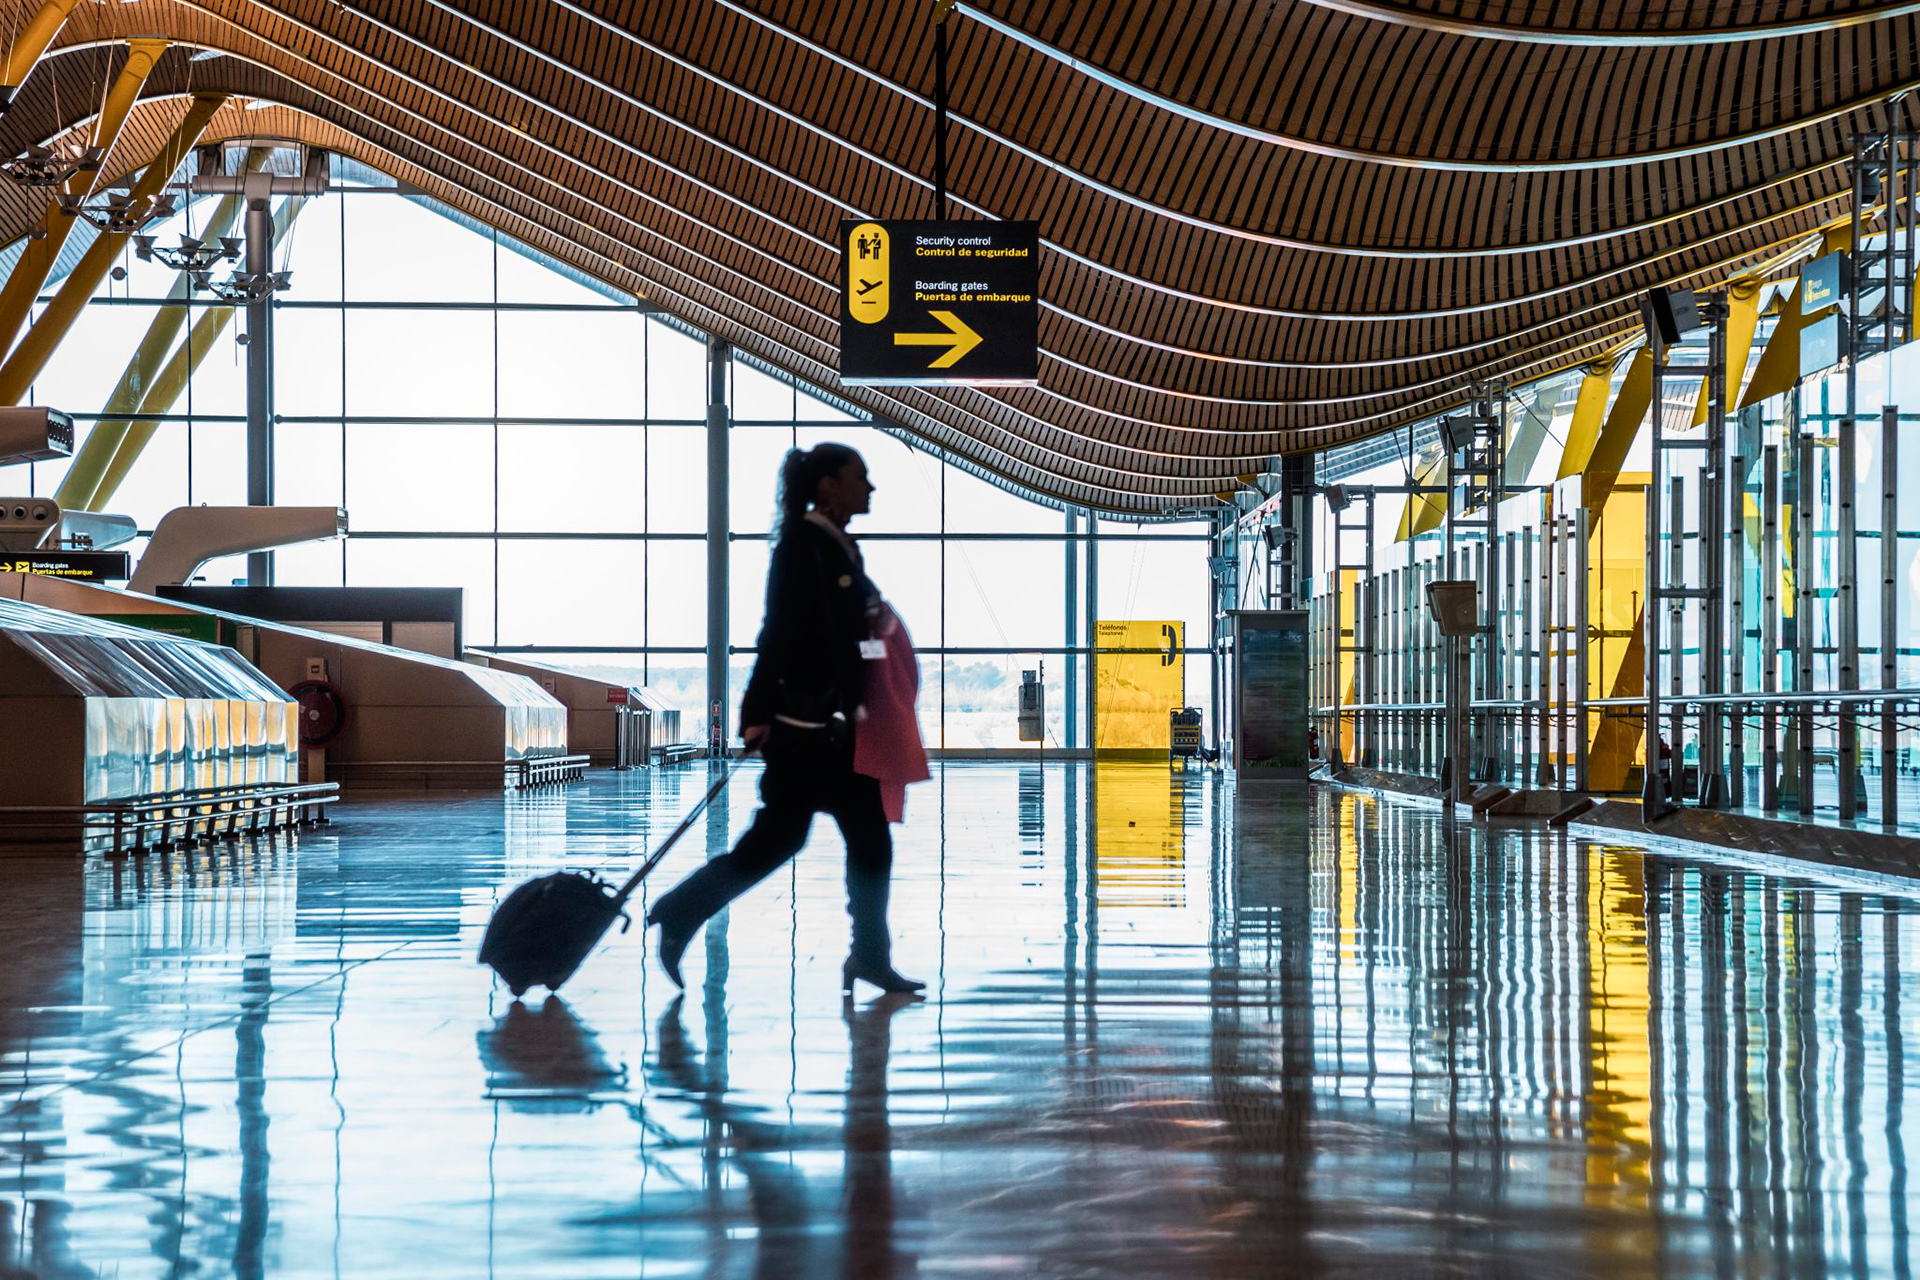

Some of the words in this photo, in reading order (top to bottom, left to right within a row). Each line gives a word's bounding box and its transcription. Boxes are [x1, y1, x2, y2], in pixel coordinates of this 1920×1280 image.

[915, 236, 955, 247] Security
[957, 236, 991, 246] control
[915, 247, 955, 257] Control
[958, 247, 972, 257] de
[975, 248, 1028, 258] seguridad
[915, 281, 958, 292] Boarding
[961, 281, 988, 292] gates
[915, 292, 957, 301] Puertas
[960, 292, 973, 301] de
[976, 292, 1031, 303] embarque
